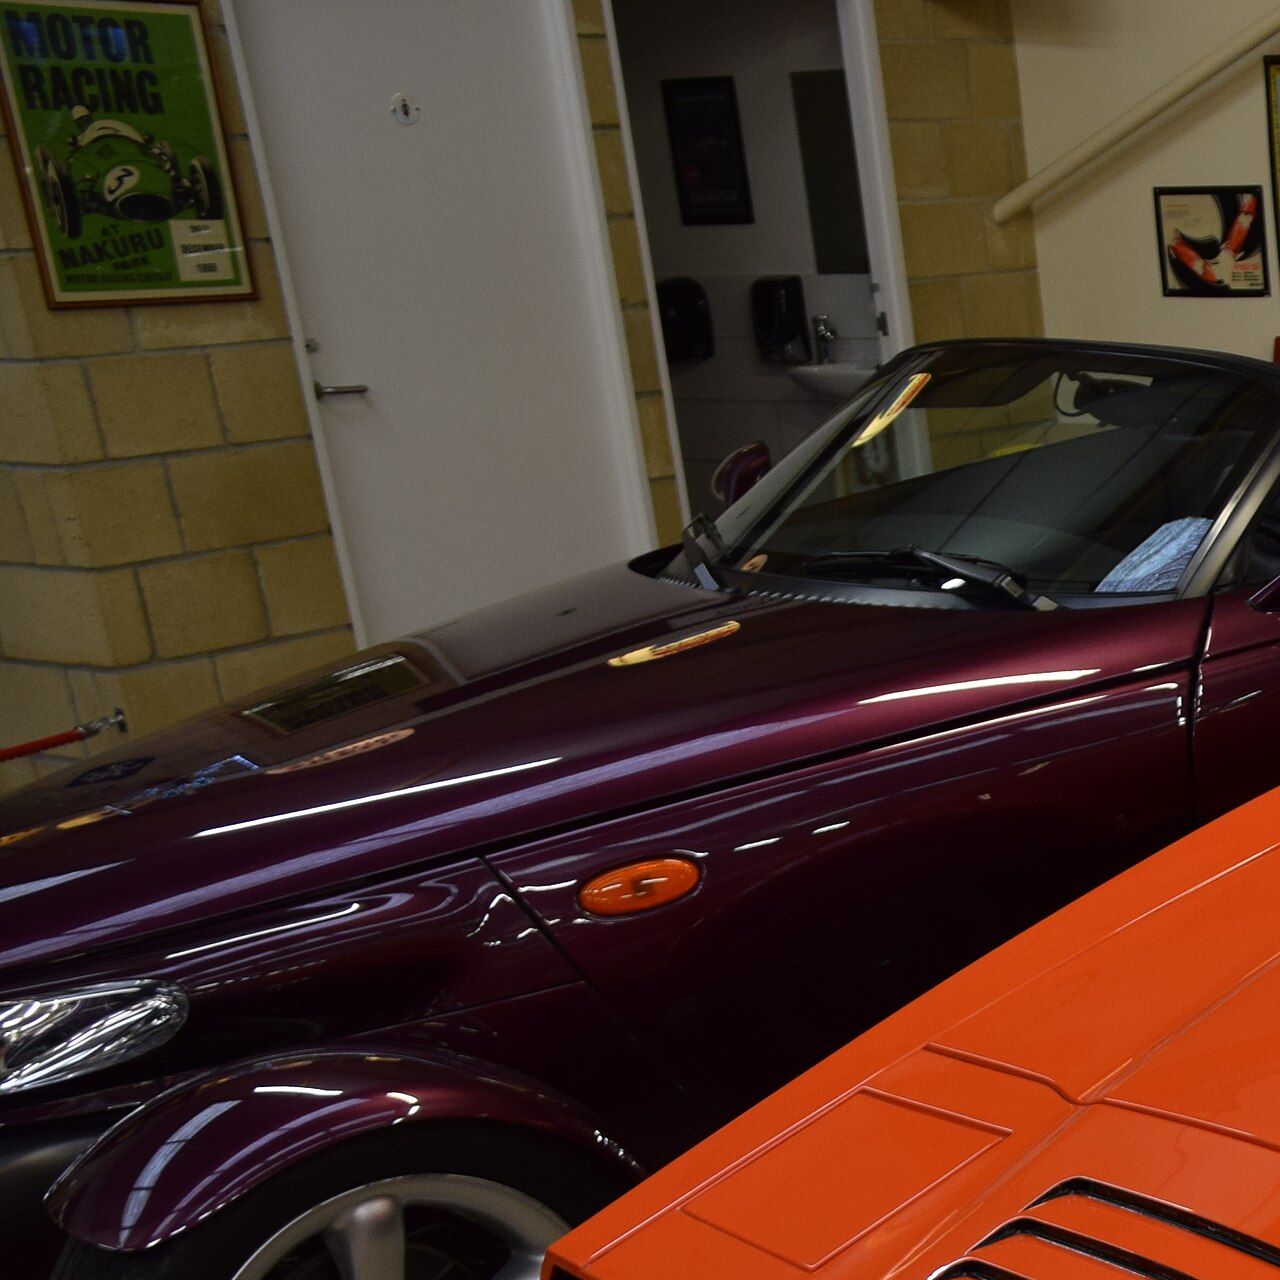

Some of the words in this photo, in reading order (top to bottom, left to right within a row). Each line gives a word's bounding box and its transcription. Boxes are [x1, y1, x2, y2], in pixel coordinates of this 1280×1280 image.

[4, 9, 155, 64] MOTOR
[18, 63, 165, 115] RACING
[108, 166, 137, 196] 3
